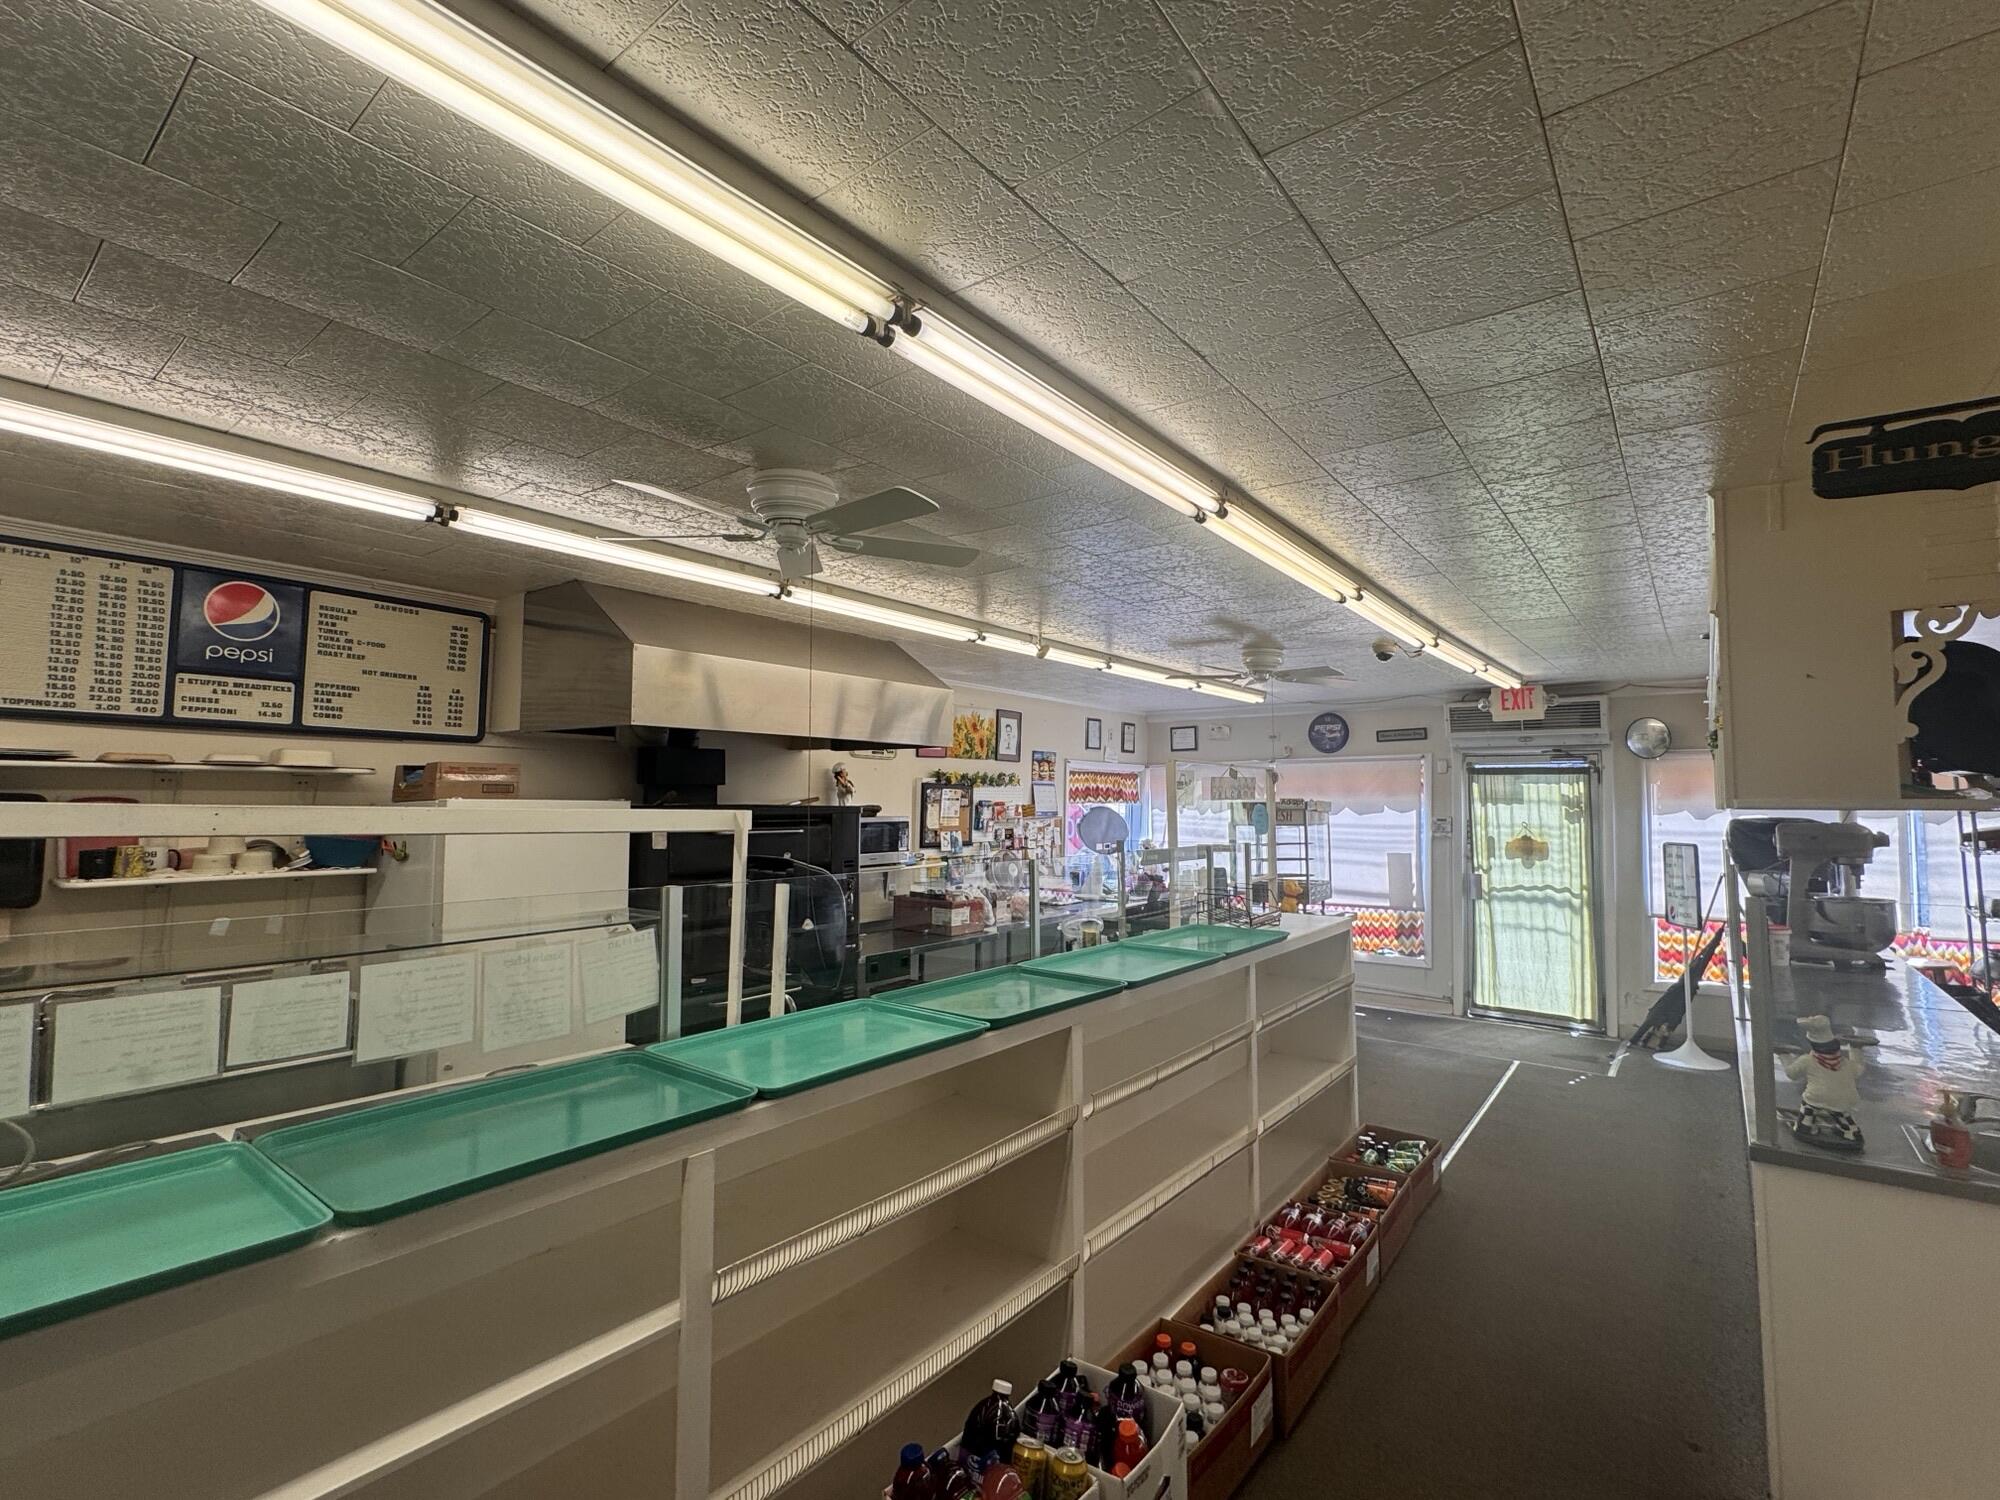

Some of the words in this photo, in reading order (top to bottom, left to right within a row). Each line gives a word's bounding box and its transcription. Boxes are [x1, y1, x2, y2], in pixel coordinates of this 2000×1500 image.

[12, 548, 50, 559] PIZZA
[50, 612, 83, 622] 12.50
[318, 627, 349, 636] TURKEY
[318, 634, 340, 643] TUNA
[317, 642, 352, 651] CHICKEN
[50, 648, 80, 656] 12.50
[205, 645, 274, 664] pepsi
[317, 650, 343, 658] ROAST
[132, 672, 160, 680] 20.00
[380, 671, 417, 680] GRINDERS
[131, 680, 160, 688] 20.00
[188, 678, 229, 688] STUFFED
[233, 682, 292, 692] BREADSTICKS
[314, 682, 360, 692] PEPPERONI
[45, 691, 75, 699] 17.00
[221, 689, 253, 697] SAUCE
[314, 690, 352, 698] SAUSAGE
[1, 698, 51, 706] TOPPING
[181, 696, 220, 704] CHEESE
[1501, 687, 1535, 710] EXIT
[181, 705, 237, 715] PEPPERONI
